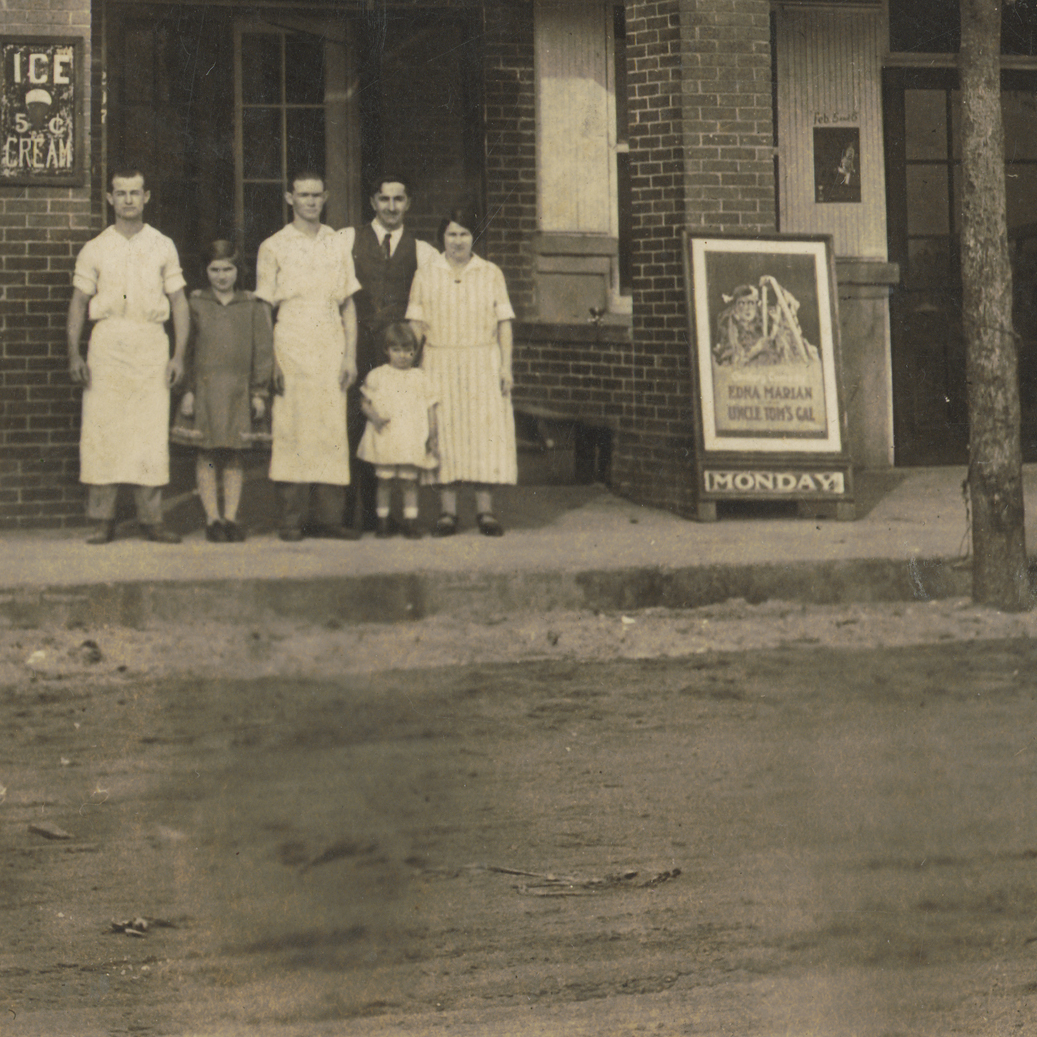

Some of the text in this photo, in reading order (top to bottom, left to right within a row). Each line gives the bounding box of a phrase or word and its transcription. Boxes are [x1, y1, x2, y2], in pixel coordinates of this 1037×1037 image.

[13, 53, 70, 85] ICE
[15, 113, 66, 135] 5 ¢
[5, 136, 72, 169] CREAM
[728, 385, 812, 400] EDNA MARIAN
[727, 406, 761, 421] UNCLE
[764, 405, 794, 421] TOM'S
[712, 472, 837, 490] MONDAY
